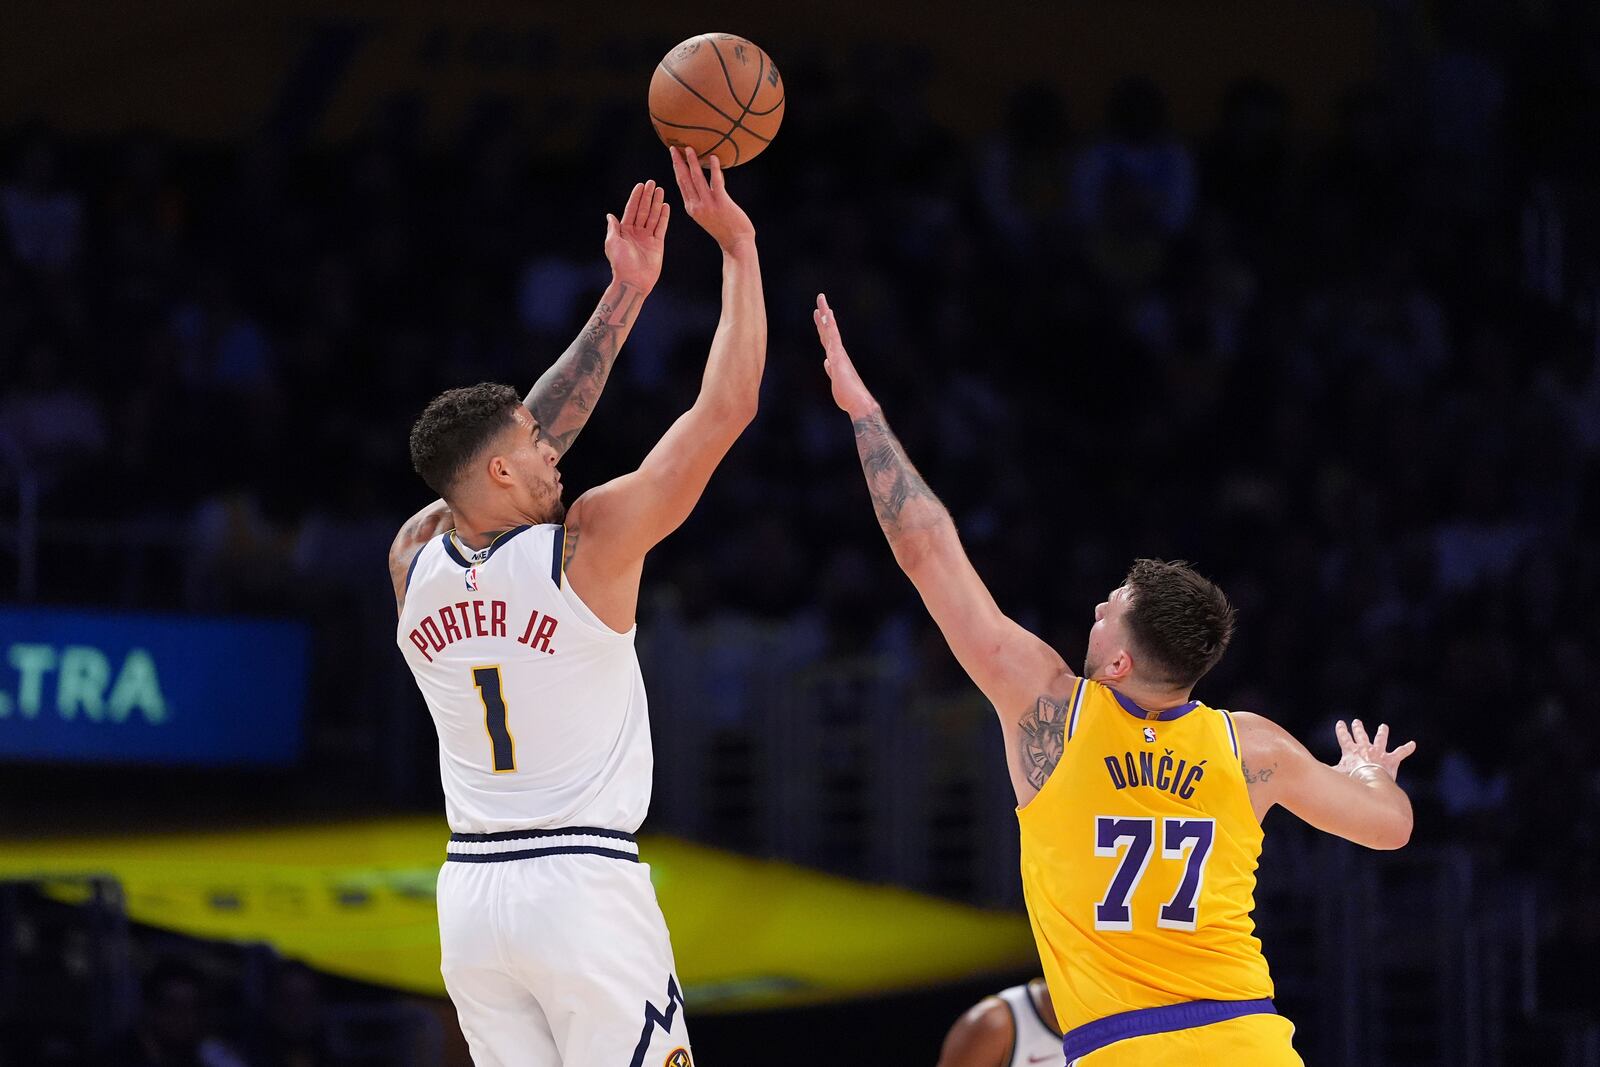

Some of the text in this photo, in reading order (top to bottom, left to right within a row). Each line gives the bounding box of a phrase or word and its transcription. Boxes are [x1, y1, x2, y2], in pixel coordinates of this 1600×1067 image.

[408, 600, 559, 663] PORTER JR.
[0, 643, 170, 724] TRA
[471, 664, 518, 774] 1
[1104, 748, 1208, 800] DONČIĆ
[1094, 815, 1217, 933] 77
